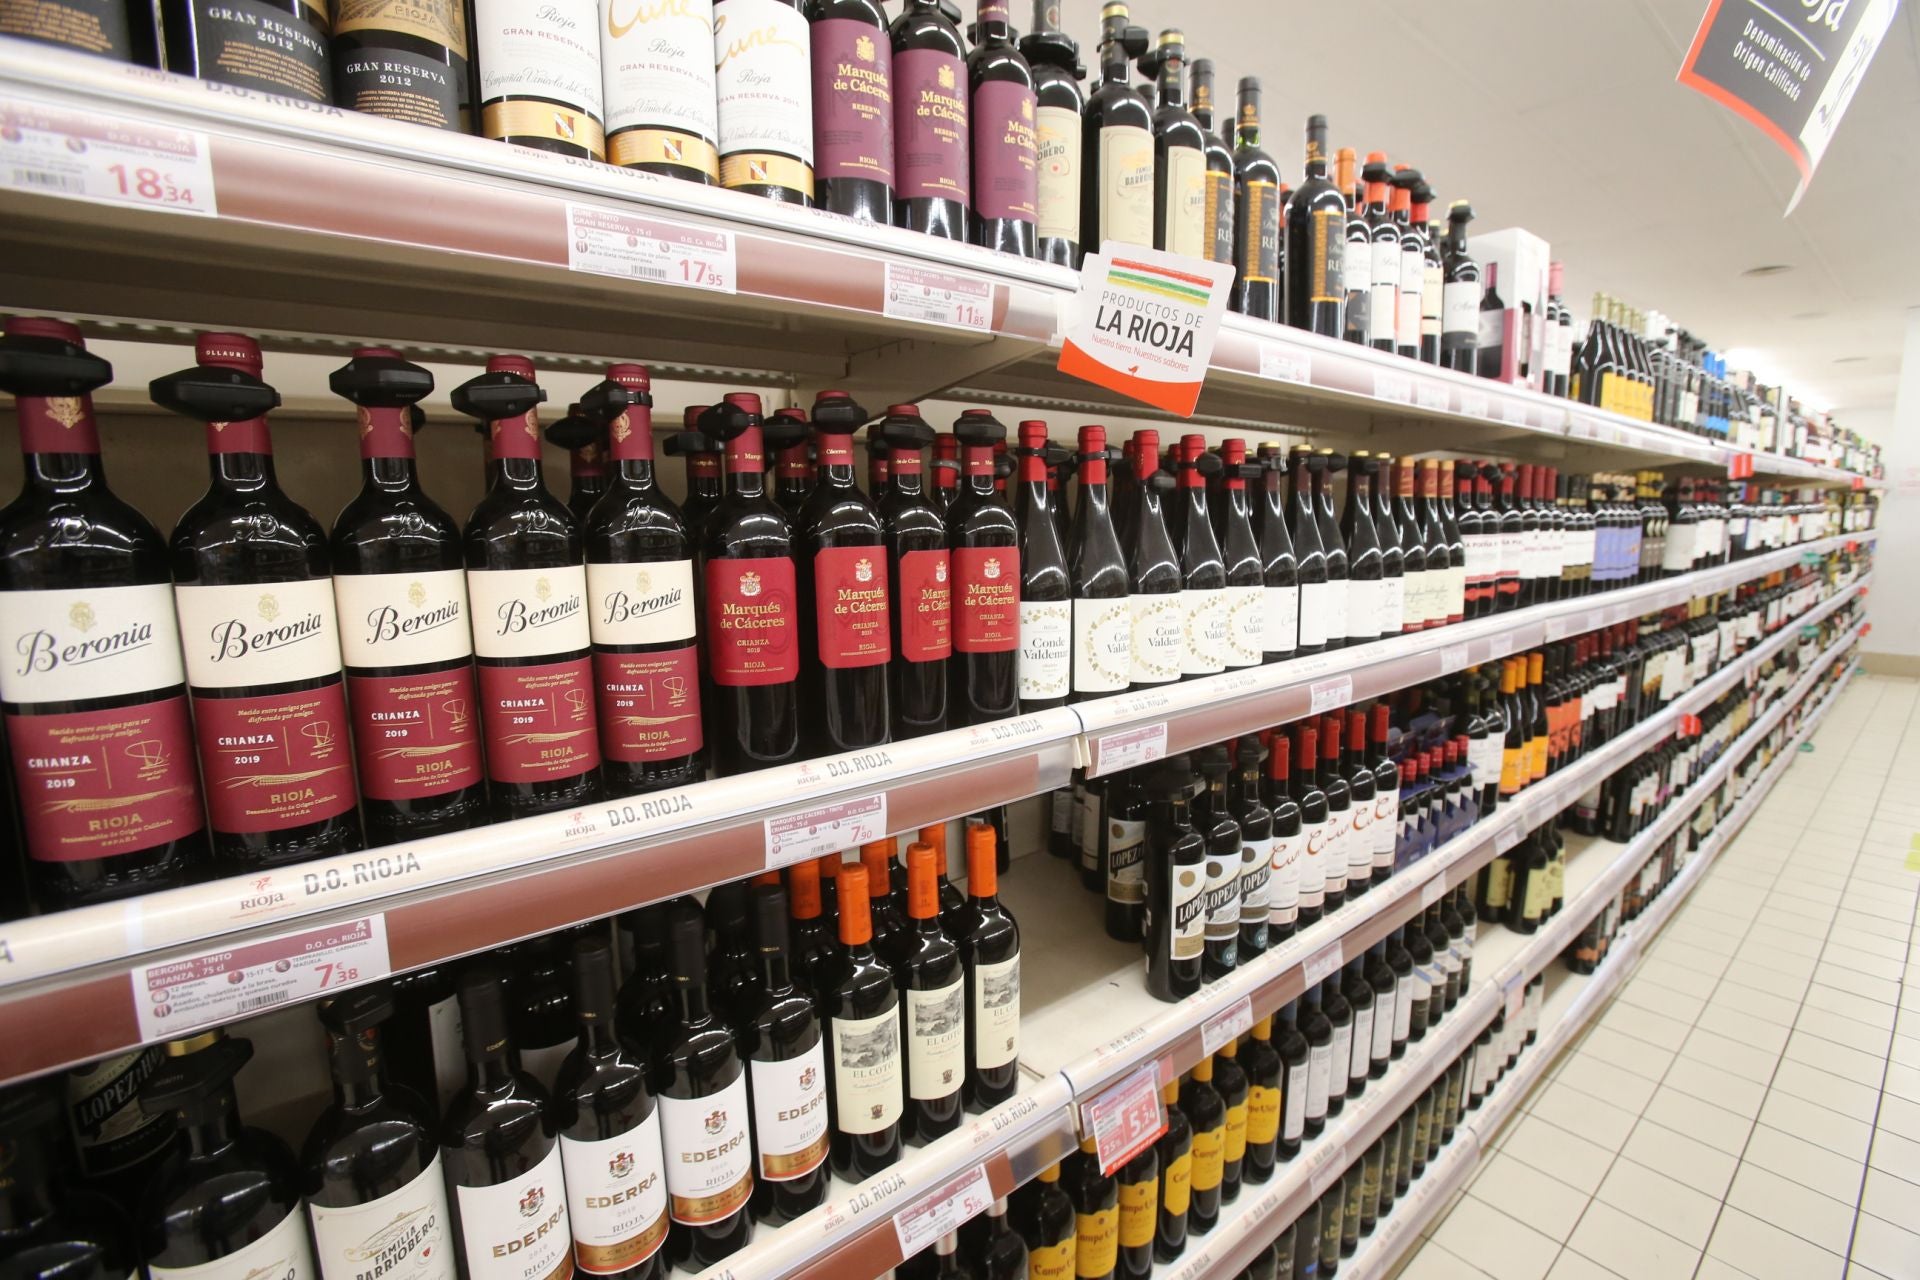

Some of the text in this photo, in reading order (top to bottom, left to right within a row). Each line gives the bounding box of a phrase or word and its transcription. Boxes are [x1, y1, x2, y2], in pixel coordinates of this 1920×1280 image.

[536, 4, 577, 30] Rioja
[208, 7, 324, 57] GRAN RESERVA
[256, 30, 295, 51] 2012
[502, 27, 585, 53] GRAN RESERVA
[648, 37, 686, 58] Rioja
[1743, 18, 1812, 82] Denominación de
[346, 61, 446, 86] GRAN RESERVA
[380, 74, 412, 87] 2012
[837, 63, 889, 88] Marqués
[1732, 40, 1802, 102] Origen Calificada
[833, 79, 891, 103] de Cáceres
[852, 102, 881, 116] RESERVA
[916, 105, 931, 117] de
[1004, 133, 1016, 144] de
[859, 156, 878, 166] RIOJA
[939, 176, 957, 187] RIOJA
[573, 216, 631, 235] GRAN RESERVA
[1101, 290, 1205, 329] PRODUCTOS DE
[1094, 304, 1196, 358] LA RIOJA
[1091, 333, 1117, 349] Nuestra
[1133, 345, 1163, 364] Nuestros
[1163, 356, 1190, 374] sabores
[837, 586, 886, 603] Marqués
[968, 583, 1014, 597] Marqués
[602, 586, 682, 625] Beronia
[723, 601, 781, 617] Marqués
[834, 600, 887, 614] de Cáceres
[918, 602, 930, 612] de
[965, 595, 1016, 606] de Cáceres
[366, 599, 460, 646] Beronia
[496, 593, 581, 637] Beronia
[720, 615, 785, 629] de Cáceres
[852, 622, 879, 630] CRIANZA
[209, 612, 322, 664] Beronia
[736, 638, 770, 647] CRIANZA
[1031, 636, 1066, 649] Conde
[16, 622, 153, 677] Beronia
[744, 661, 766, 669] RIOJA
[606, 684, 645, 692] CRIANZA
[500, 698, 545, 708] CRIANZA
[616, 699, 634, 707] 2019
[371, 710, 420, 721] CRIANZA
[513, 716, 534, 724] 2019
[218, 734, 275, 746] CRIANZA
[385, 729, 408, 738] 2019
[639, 730, 671, 741] RIOJA
[990, 719, 1044, 741] D.O. RIOJA
[27, 755, 93, 769] CRIANZA
[234, 755, 261, 765] 2019
[541, 746, 574, 759] RIOJA
[416, 760, 454, 774] RIOJA
[826, 751, 894, 778] D.O. RIOJA
[45, 777, 76, 790] 2019
[270, 788, 315, 805] RIOJA
[607, 793, 694, 827] D.O. RIOJA
[88, 812, 144, 832] RIOJA
[1111, 848, 1141, 866] LOPEZ
[302, 870, 349, 897] D.O.
[352, 851, 422, 886] RIOJA
[1206, 885, 1235, 910] LOPEZ
[305, 930, 368, 951] D.O. Ca. RIOJA
[147, 952, 233, 979] BERONIA TINTO
[148, 963, 225, 989] CRIANZA 75 cl
[926, 1037, 940, 1047] EL
[852, 1061, 895, 1080] EL COTO
[80, 1070, 138, 1127] LOPEZ
[991, 1095, 1039, 1132] D.O. RIOJA
[681, 1130, 746, 1164] EDERRA
[704, 1168, 736, 1188] RIOJA
[585, 1171, 659, 1210] EDERRA
[849, 1173, 907, 1215] D.O. RIOJA
[492, 1203, 566, 1259] EDERRA
[612, 1213, 646, 1234] RIOJA
[374, 1224, 418, 1265] FAMILIA
[523, 1250, 557, 1278] RIOJA
[1034, 1260, 1067, 1276] Campo
